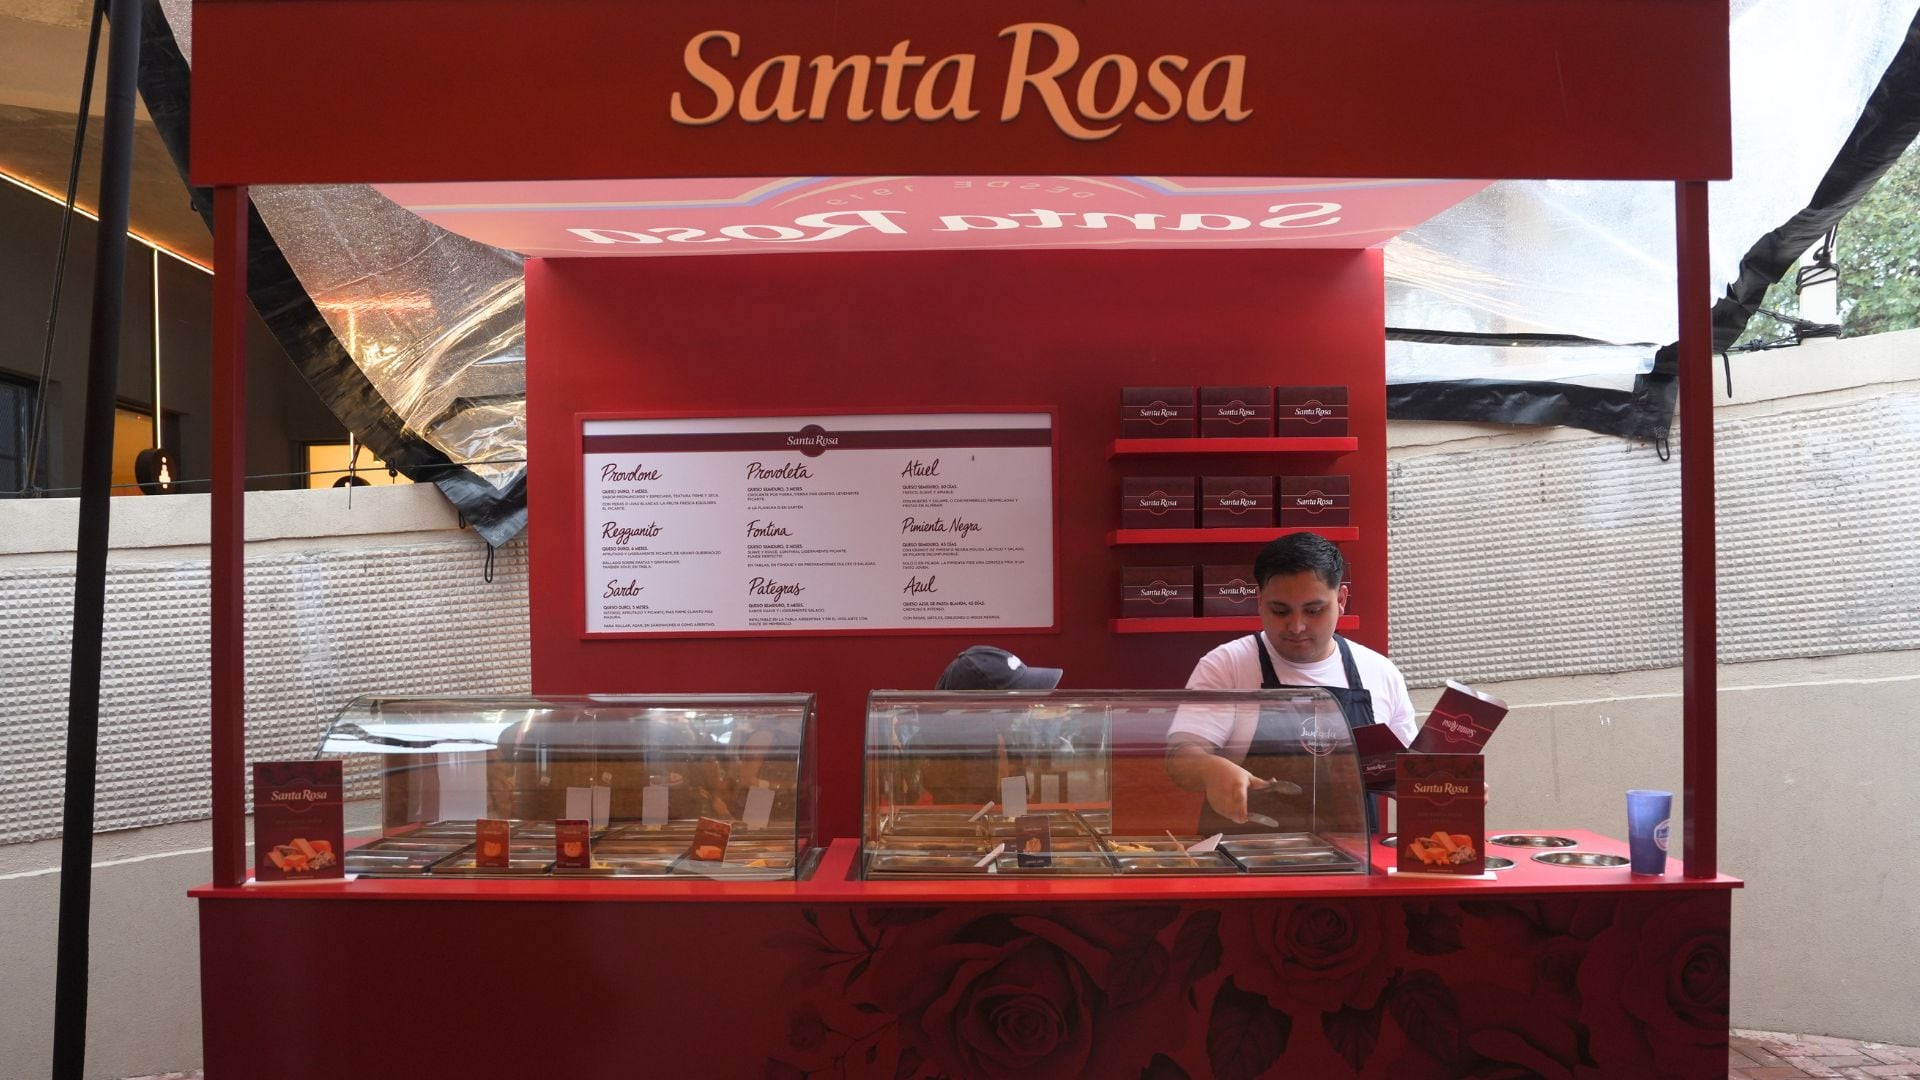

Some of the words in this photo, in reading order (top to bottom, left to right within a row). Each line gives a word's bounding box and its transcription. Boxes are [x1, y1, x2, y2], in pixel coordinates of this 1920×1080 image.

[669, 30, 982, 126] Santa
[998, 21, 1254, 141] Rosa
[1160, 408, 1177, 417] Rosa
[1238, 408, 1255, 417] Rosa
[1315, 407, 1331, 416] Rosa
[786, 435, 814, 446] Santa
[815, 434, 838, 446] Rosa
[601, 463, 663, 482] Provolone
[747, 462, 813, 480] Provoleta
[901, 459, 940, 478] Atuel
[1160, 498, 1177, 507] Rosa
[1220, 498, 1239, 506] Santa
[1240, 498, 1256, 507] Rosa
[1316, 497, 1333, 506] Rosa
[602, 521, 663, 544] Reggianito
[747, 520, 793, 538] Fontina
[902, 517, 948, 534] Pimienta
[948, 517, 982, 538] Negra
[603, 579, 644, 599] Sardo
[748, 577, 805, 602] Pategras
[903, 575, 938, 596] Azul
[1239, 586, 1256, 595] Rosa
[1161, 588, 1177, 597] Rosa
[272, 791, 300, 801] Santa
[303, 789, 327, 801] Rosa
[1414, 783, 1443, 793] Santa
[1445, 783, 1469, 795] Rosa
